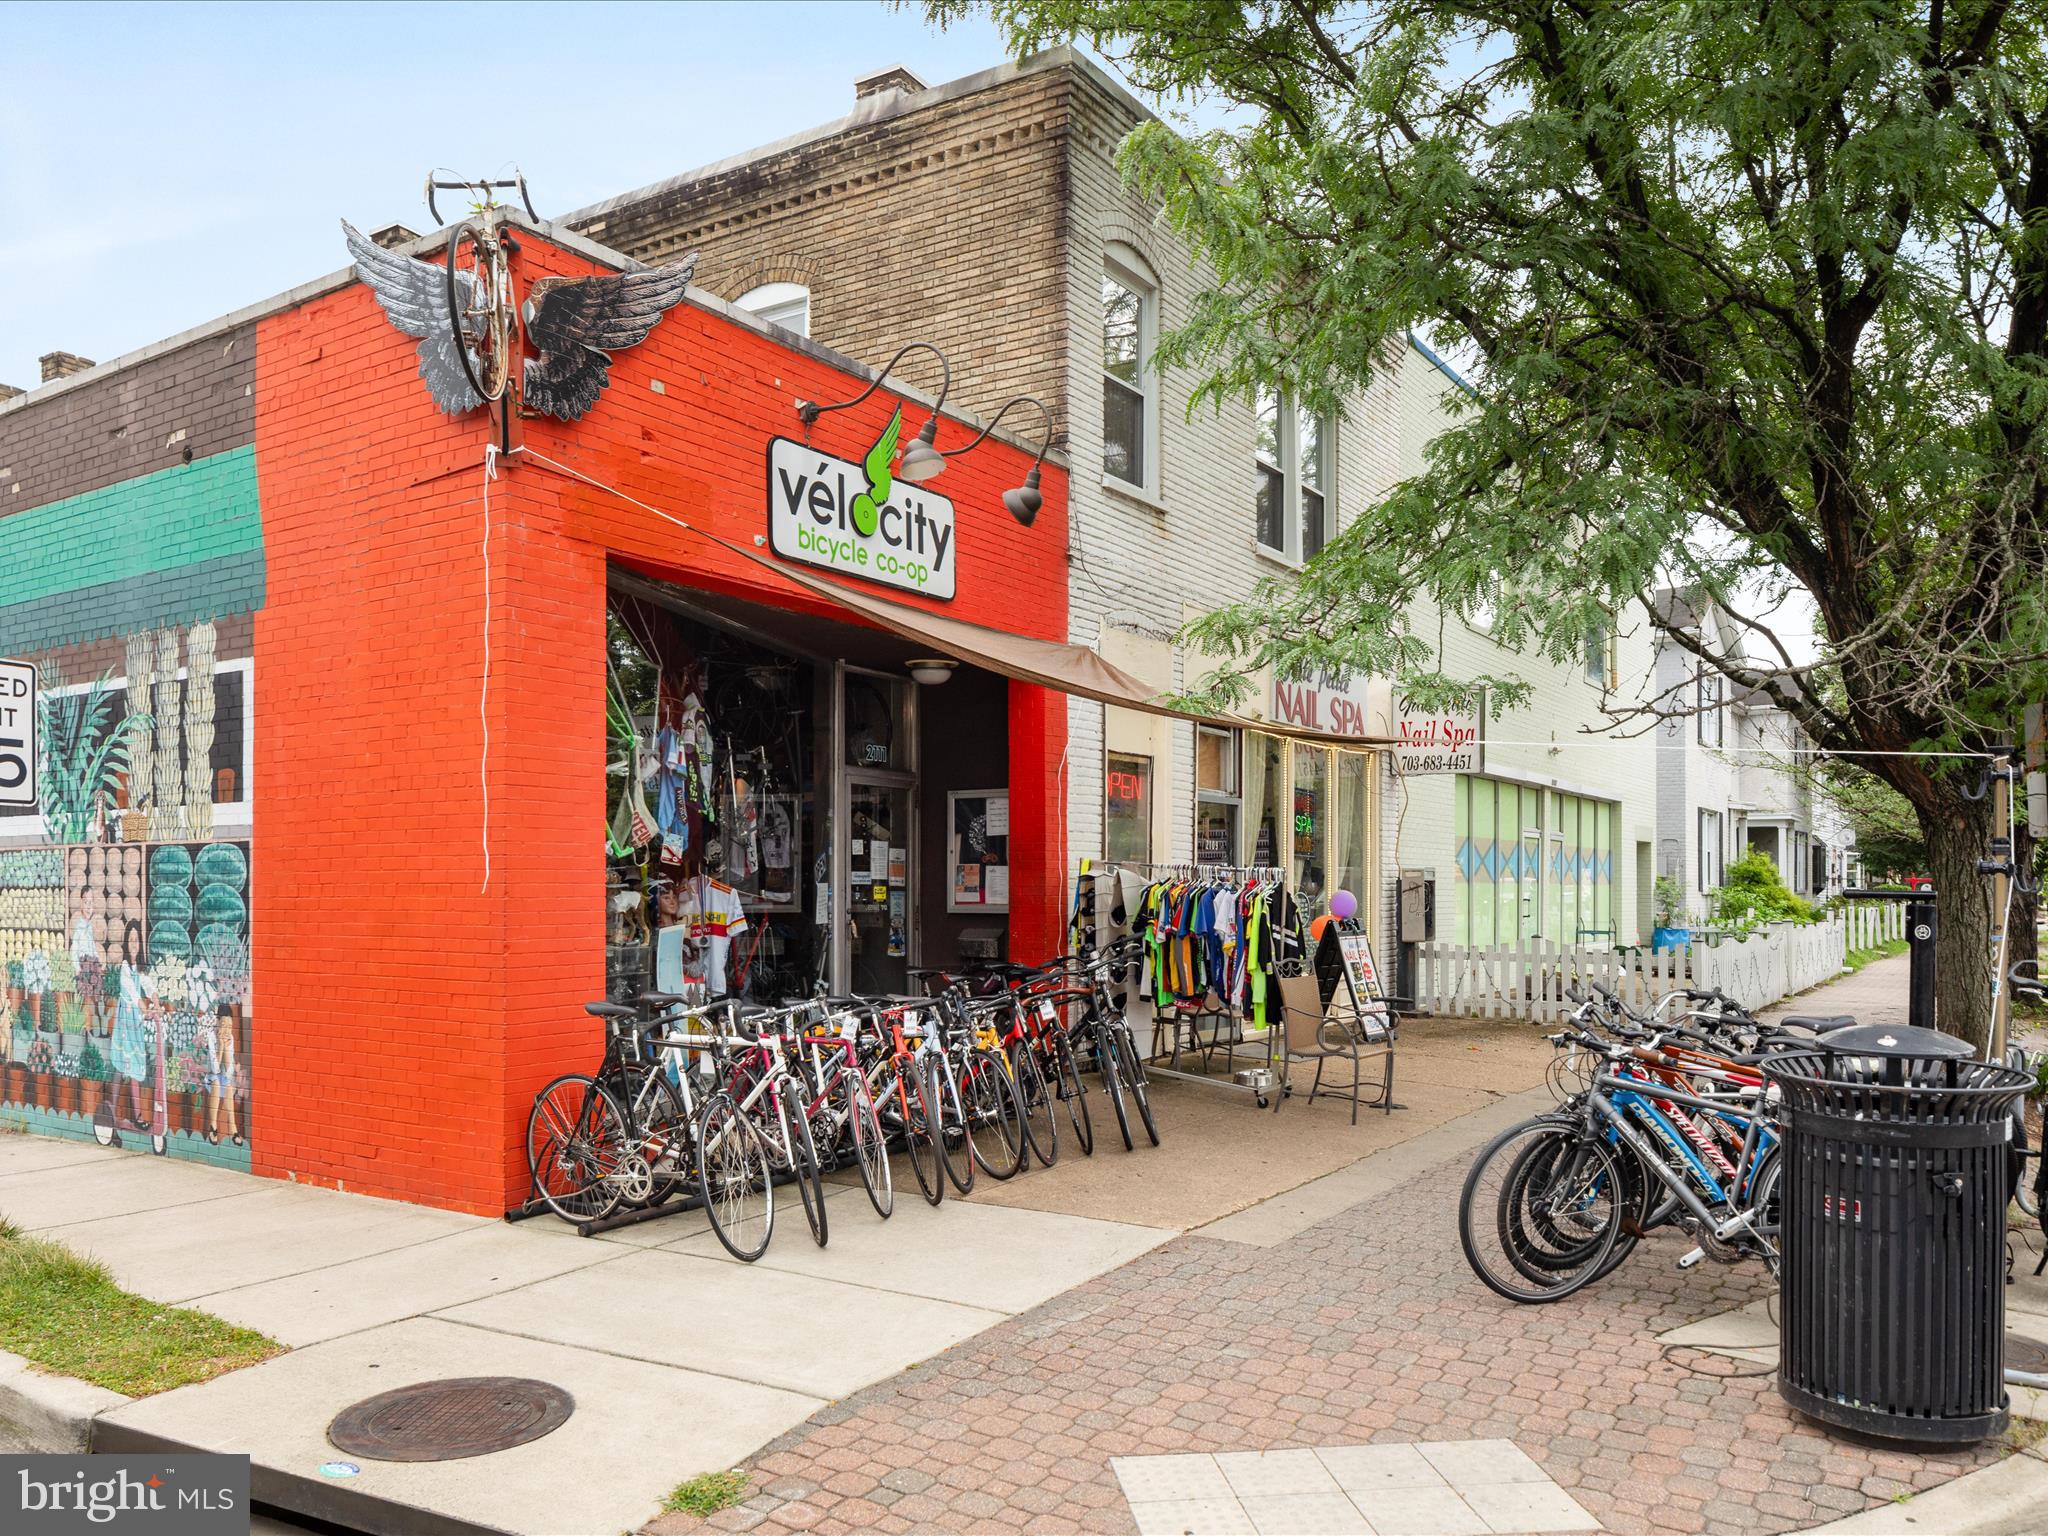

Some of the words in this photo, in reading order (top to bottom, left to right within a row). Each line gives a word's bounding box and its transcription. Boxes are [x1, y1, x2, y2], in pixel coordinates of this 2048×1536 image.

[798, 523, 868, 565] bicycle
[876, 552, 928, 587] co-op
[1275, 679, 1323, 730] NAIL
[1330, 696, 1365, 735] SPA
[866, 744, 887, 762] 2111
[1397, 720, 1436, 748] Nail
[1442, 719, 1475, 753] Spa
[1402, 754, 1472, 771] 703-683-4451
[1296, 815, 1313, 833] SPA
[1664, 1107, 1737, 1176] SPECIALIZED
